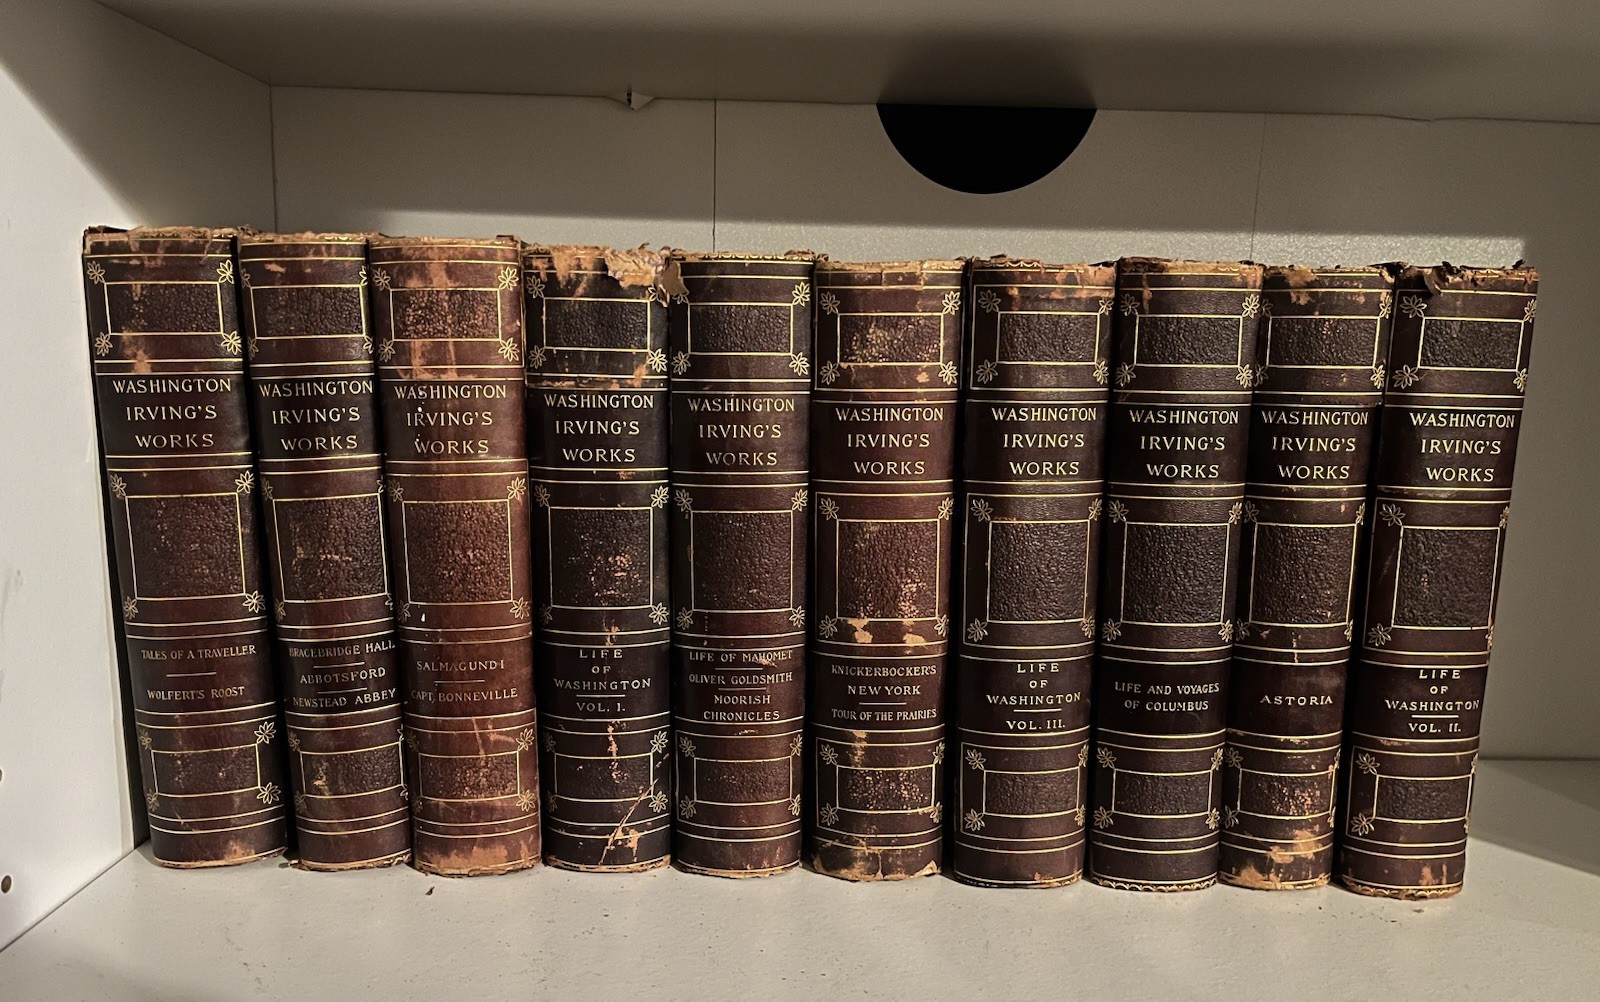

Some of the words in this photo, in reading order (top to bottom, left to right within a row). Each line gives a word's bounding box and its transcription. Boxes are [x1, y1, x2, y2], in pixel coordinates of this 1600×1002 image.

[112, 378, 232, 395] WASHINGTON
[258, 379, 374, 398] WASHINGTON
[394, 384, 507, 400] WASHINGTON
[544, 393, 655, 409] WASHINGTON
[687, 397, 795, 412] WASHINGTON
[126, 404, 218, 421] IRVING'S
[272, 406, 361, 425] IRVING'S
[406, 411, 493, 427] IRVING'S
[835, 407, 945, 422] WASHINGTON
[991, 407, 1097, 422] WASHINGTON
[1129, 409, 1240, 425] WASHINGTON
[1261, 410, 1369, 426] WASHINGTON
[555, 419, 640, 435] IRVING'S
[1409, 412, 1515, 429] WASHINGTON
[699, 423, 782, 438] IRVING'S
[134, 432, 215, 449] WORKS
[280, 435, 359, 451] WORKS
[414, 438, 490, 455] WORKS
[847, 433, 931, 448] IRVING'S
[1002, 433, 1085, 448] IRVING'S
[1140, 435, 1226, 451] IRVING'S
[1272, 437, 1357, 452] IRVING'S
[1420, 438, 1502, 455] IRVING'S
[562, 448, 636, 463] WORKS
[705, 452, 778, 467] WORKS
[853, 460, 925, 476] WORKS
[1008, 461, 1080, 476] WORKS
[1146, 463, 1220, 479] WORKS
[1277, 465, 1351, 480] WORKS
[1426, 467, 1495, 483] WORKS
[141, 649, 168, 661] TALES
[170, 650, 184, 660] OF
[186, 649, 195, 659] A
[197, 644, 257, 659] TRAVELLER
[289, 645, 361, 658] BRACEBRIDGE
[365, 640, 395, 654] HALL
[578, 648, 623, 659] LIFE
[688, 651, 715, 662] LIFE
[720, 653, 737, 662] OF
[742, 650, 793, 663] MAHOMET
[416, 659, 506, 671] SALMAGUNDI
[591, 665, 611, 674] OF
[831, 664, 937, 677] KNICKERBOCKER'S
[1016, 663, 1060, 674] LIFE
[300, 667, 387, 685] ABBOTSFORD
[688, 673, 726, 684] OLIVER
[731, 671, 793, 685] GOLDSMITH
[1418, 669, 1462, 680] LIFE
[553, 678, 652, 691] WASHINGTON
[847, 685, 882, 696] NEW
[884, 685, 922, 696] YORK
[1029, 679, 1049, 689] OF
[1114, 681, 1142, 694] LIFE
[1148, 685, 1172, 696] AND
[1176, 682, 1221, 695] VOYAGES
[1429, 685, 1449, 695] OF
[146, 689, 206, 701] WOLFERT'S
[210, 686, 245, 699] ROOST
[293, 696, 347, 708] NEWSTEAD
[354, 688, 397, 706] ABBEY
[438, 687, 519, 702] BONNEVILLE
[714, 694, 771, 705] MOORISH
[986, 692, 1081, 706] WASHINGTON
[1260, 695, 1333, 706] ASTORIA
[575, 702, 610, 713] VOL.
[616, 702, 626, 712] I.
[1124, 699, 1140, 710] OF
[1145, 701, 1210, 712] COLUMBUS
[1384, 699, 1481, 712] WASHINGTON
[703, 710, 780, 721] CHRONICLES
[831, 708, 857, 721] TOUR
[859, 711, 873, 721] OF
[874, 711, 894, 721] THE
[895, 708, 937, 721] PRAIRIES
[1005, 720, 1042, 731] VOL.
[1046, 719, 1066, 730] III.
[1408, 722, 1441, 734] VOL.
[1448, 723, 1462, 733] II.
